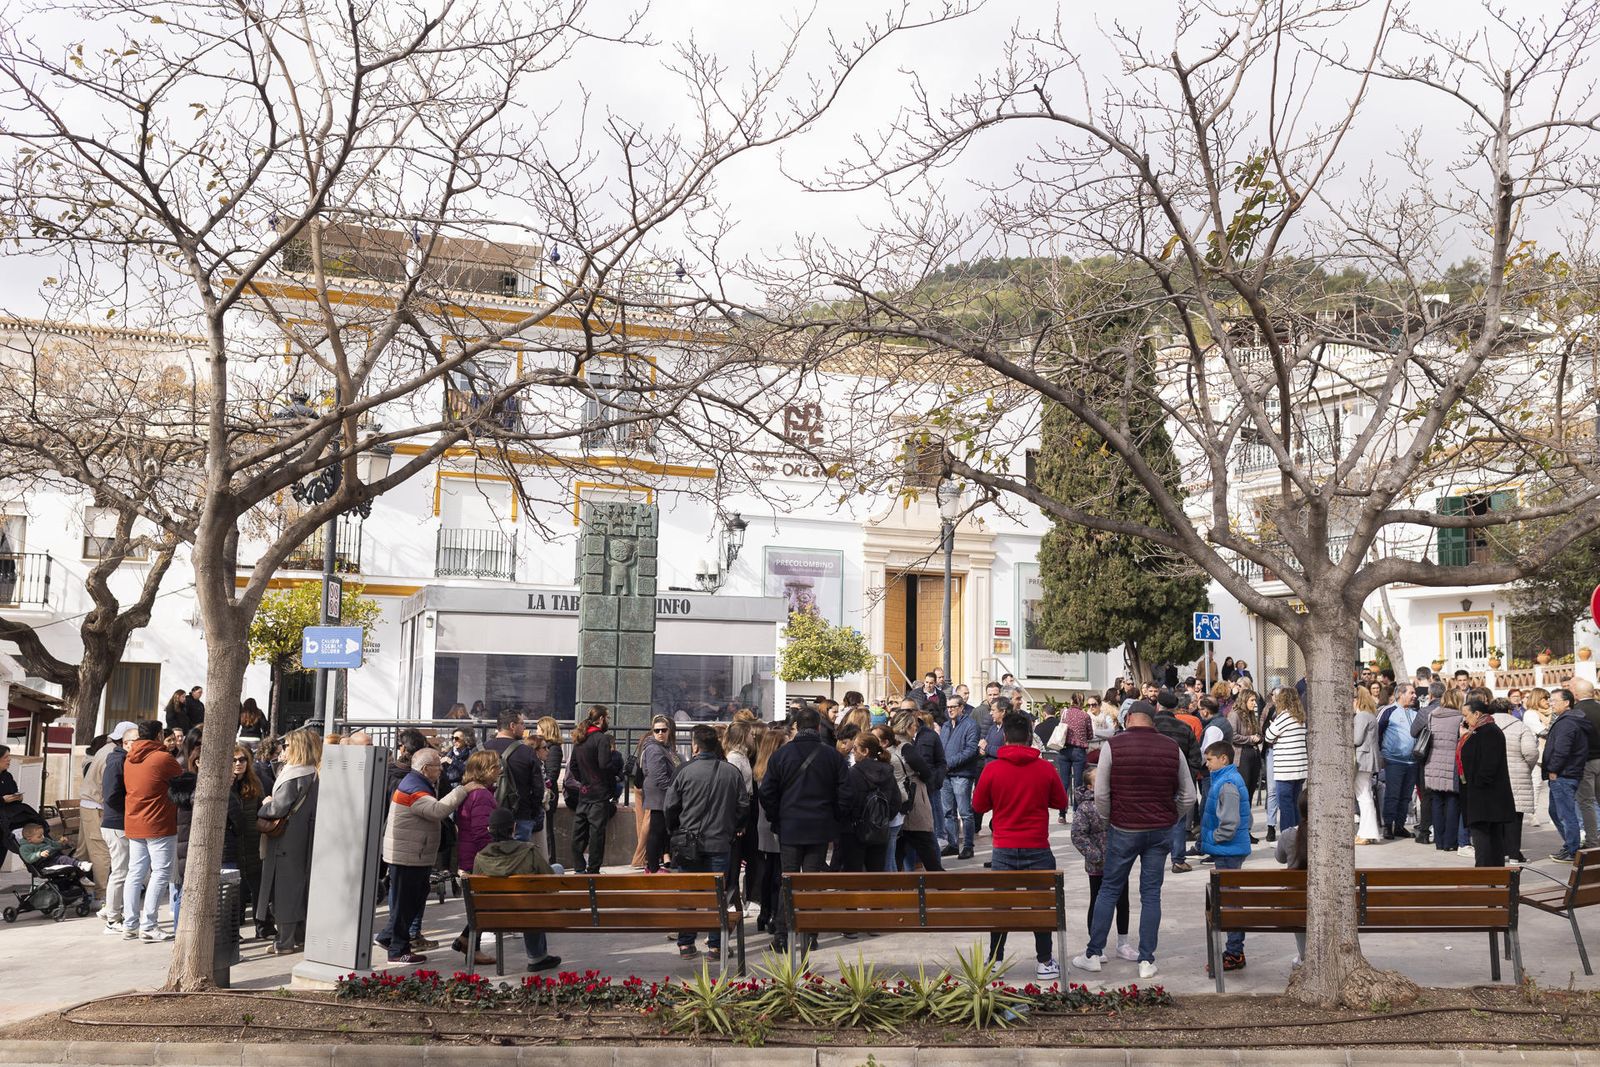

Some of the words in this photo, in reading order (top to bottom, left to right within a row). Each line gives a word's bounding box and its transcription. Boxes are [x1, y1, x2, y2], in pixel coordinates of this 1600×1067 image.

[775, 559, 834, 569] PRECOLOMBINO
[527, 594, 546, 610] LA
[551, 594, 581, 611] TAB
